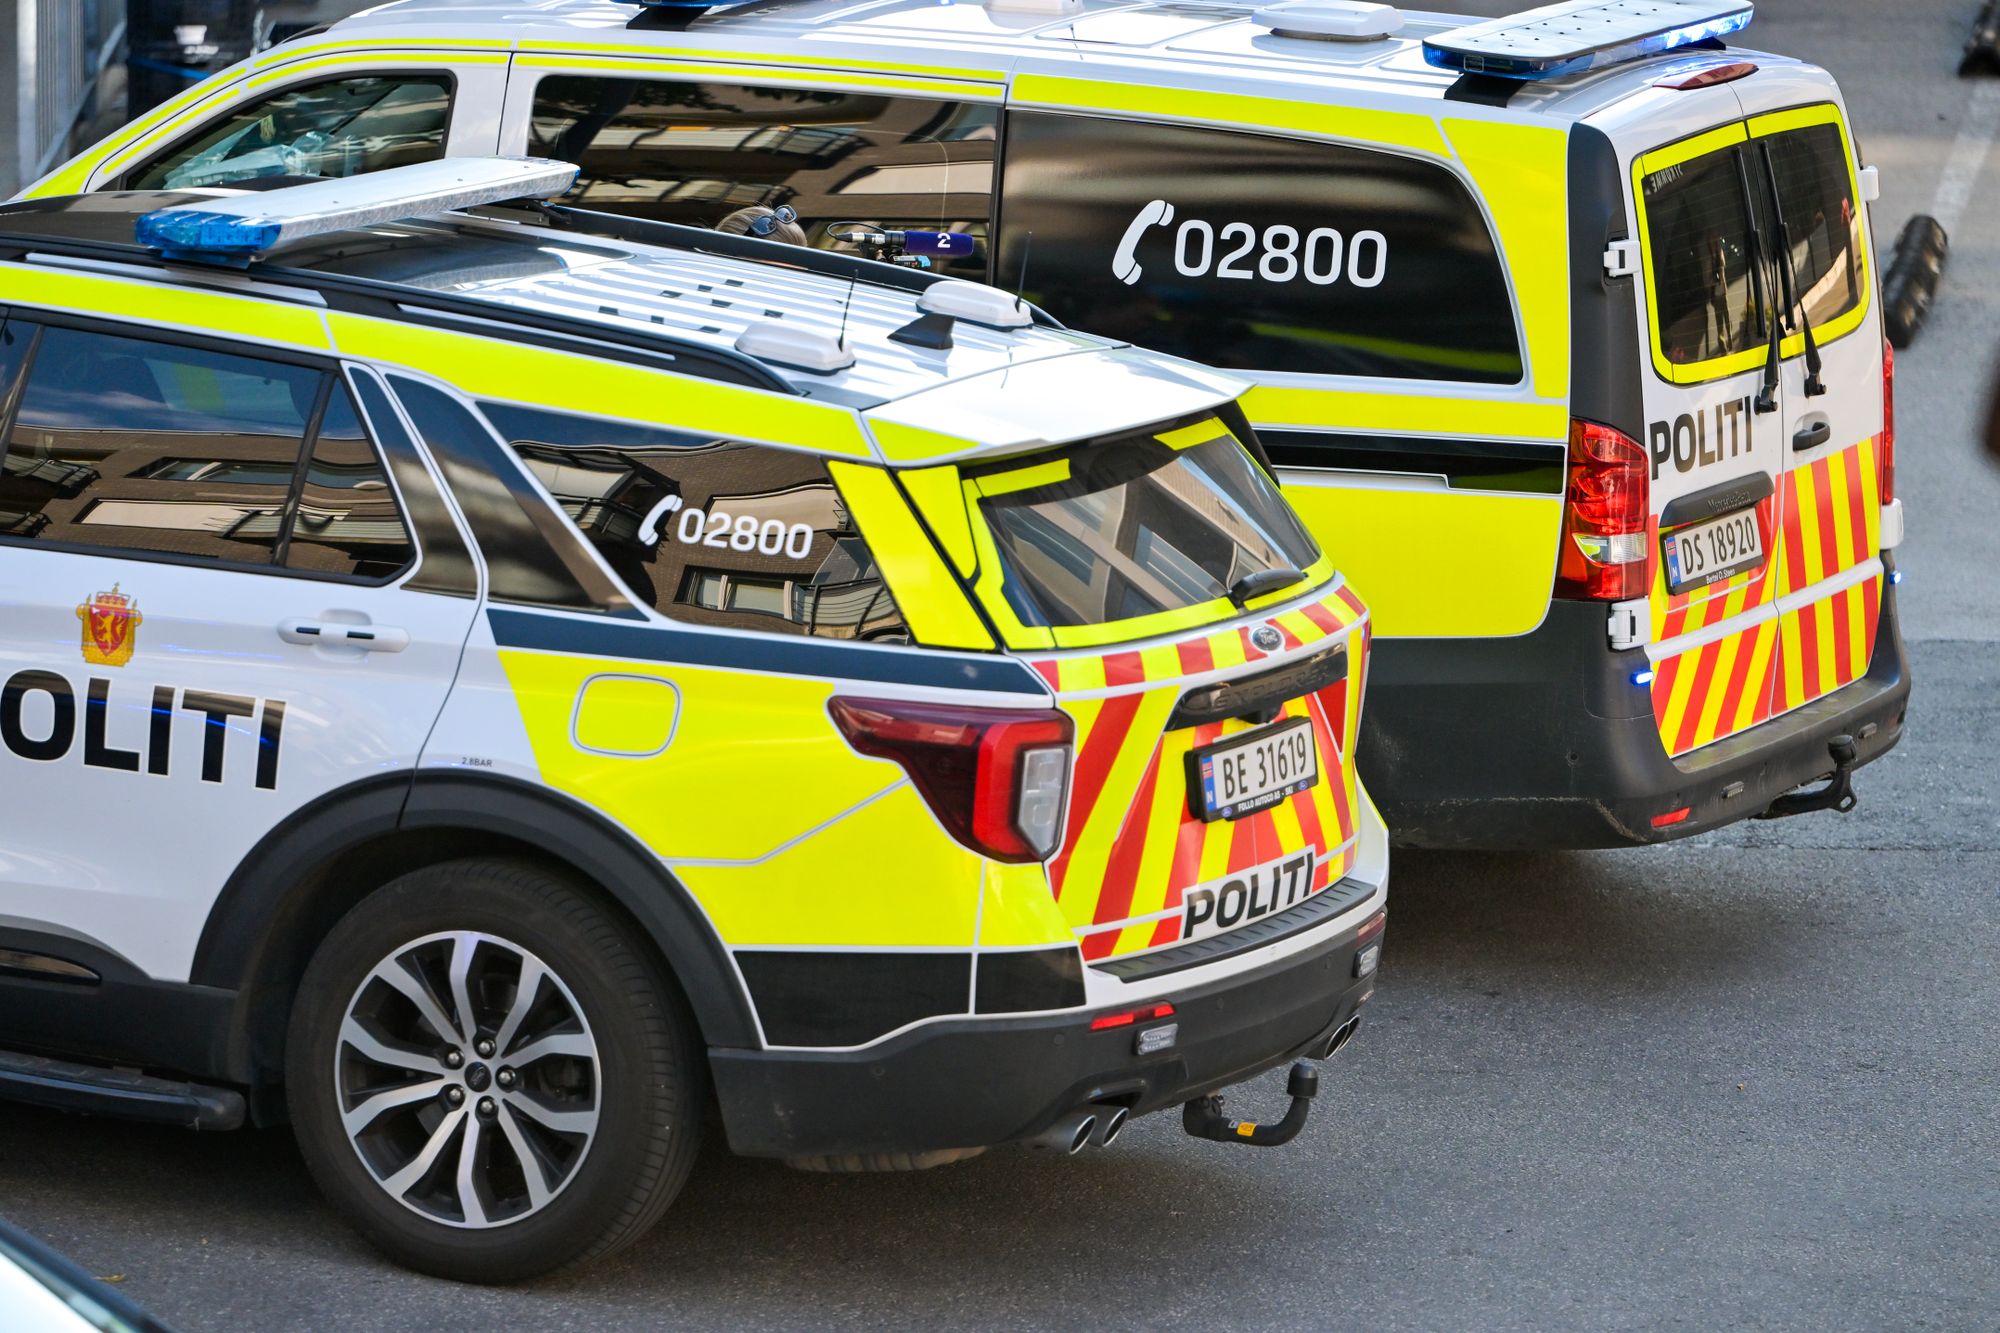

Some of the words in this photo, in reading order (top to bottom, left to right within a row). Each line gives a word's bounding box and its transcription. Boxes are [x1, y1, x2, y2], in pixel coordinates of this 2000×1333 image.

[937, 232, 951, 249] 2
[1174, 219, 1388, 288] 02800
[1649, 395, 1752, 480] POLITI
[677, 507, 814, 560] 02800
[1681, 533, 1705, 575] DS
[1708, 515, 1756, 565] 18920
[1222, 753, 1248, 800] BE
[1256, 732, 1307, 788] 31619
[1206, 791, 1213, 803] N
[1238, 799, 1254, 812] FOLLO
[1183, 851, 1314, 940] POLITI
